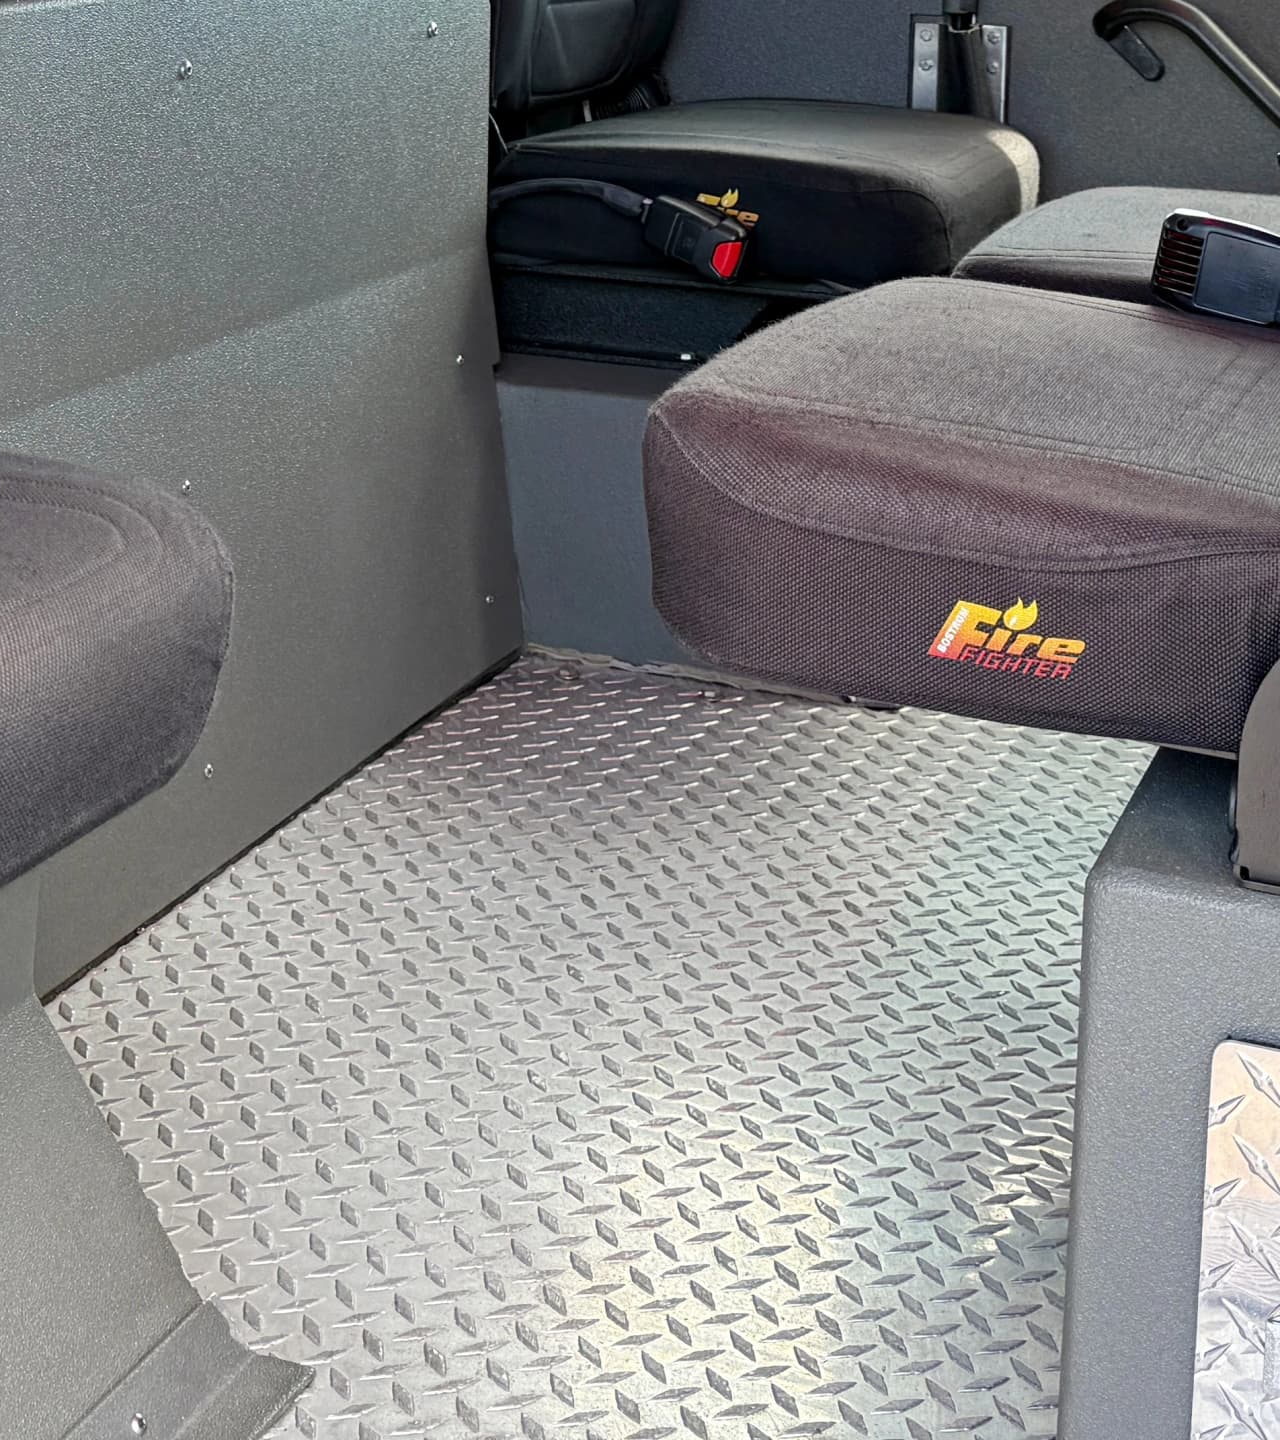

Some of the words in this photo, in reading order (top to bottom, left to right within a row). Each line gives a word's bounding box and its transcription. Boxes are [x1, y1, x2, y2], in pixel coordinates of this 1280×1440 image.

[927, 596, 1087, 664] Fire
[936, 607, 969, 654] BOSTROM
[960, 646, 1073, 681] FIGHTER
